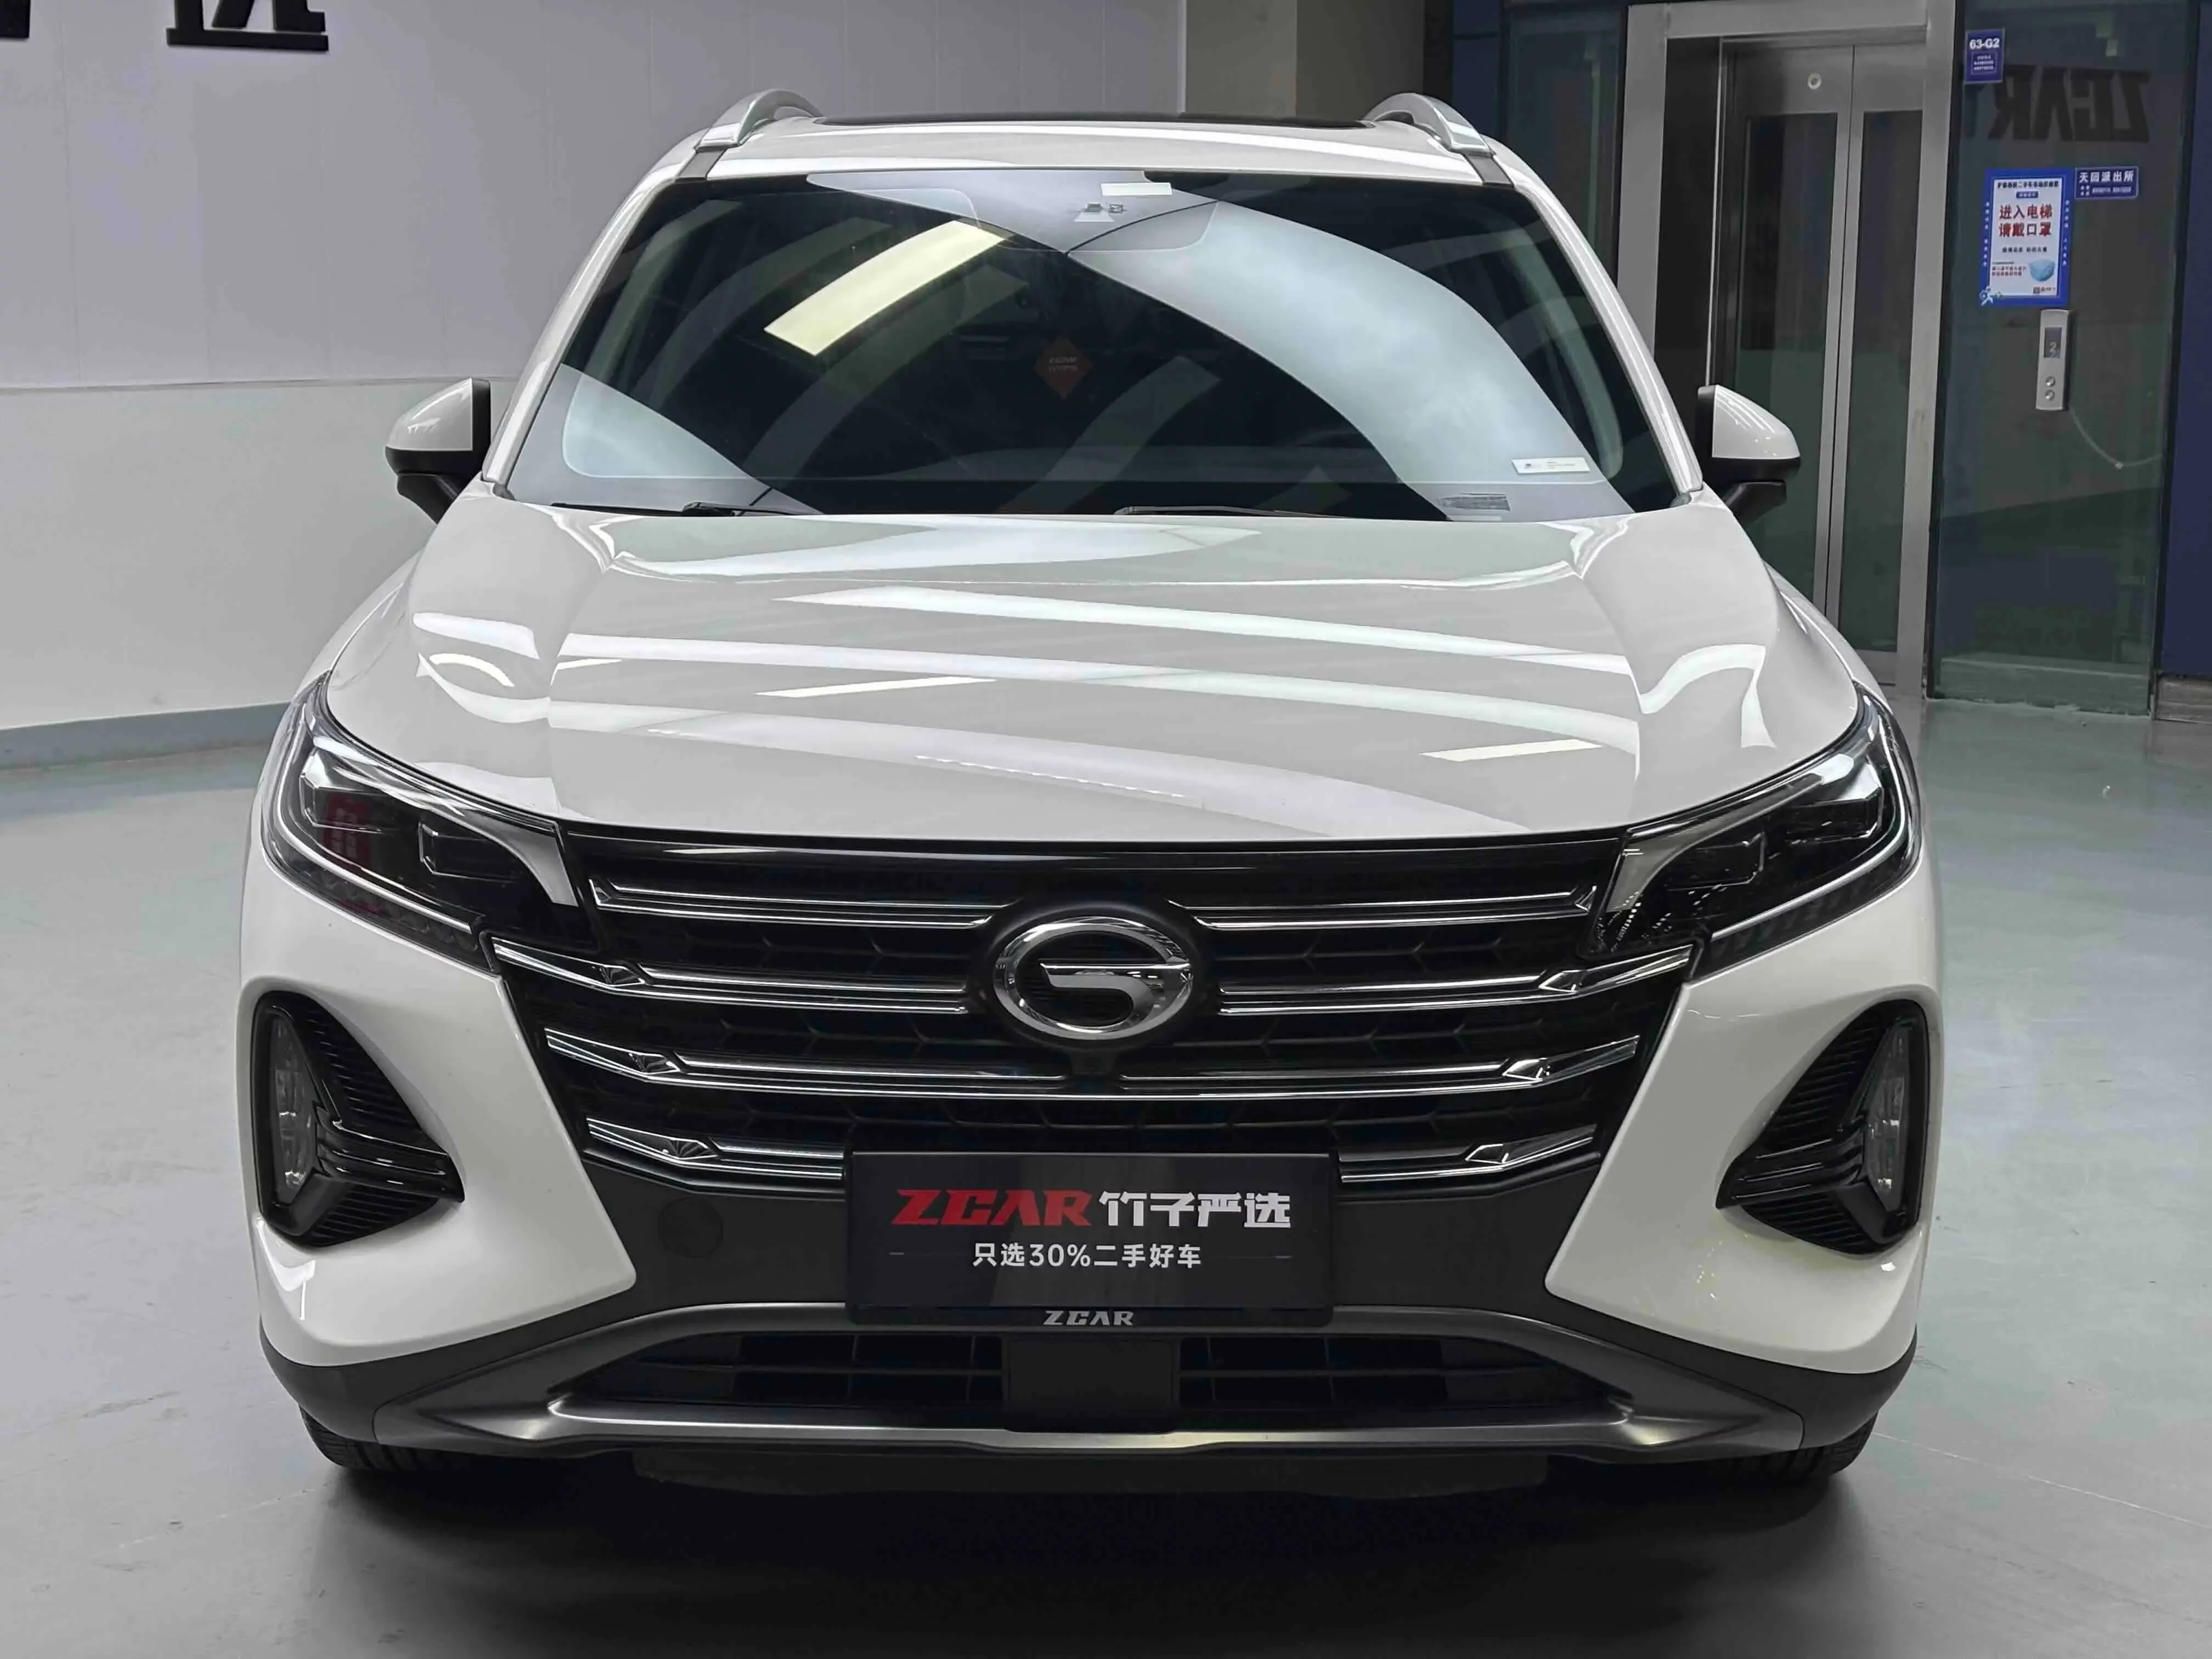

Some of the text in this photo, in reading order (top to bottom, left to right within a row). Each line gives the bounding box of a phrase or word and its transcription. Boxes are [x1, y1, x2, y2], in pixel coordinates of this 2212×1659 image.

[1969, 38, 2000, 49] 63-G2
[1999, 203, 2053, 219] 进入电梯
[1999, 222, 2052, 237] 请戴口罩
[891, 1189, 1291, 1228] ZCAR 竹子严选
[973, 1243, 1201, 1268] 只选30%二手好车
[1043, 1310, 1134, 1325] ZCAR
